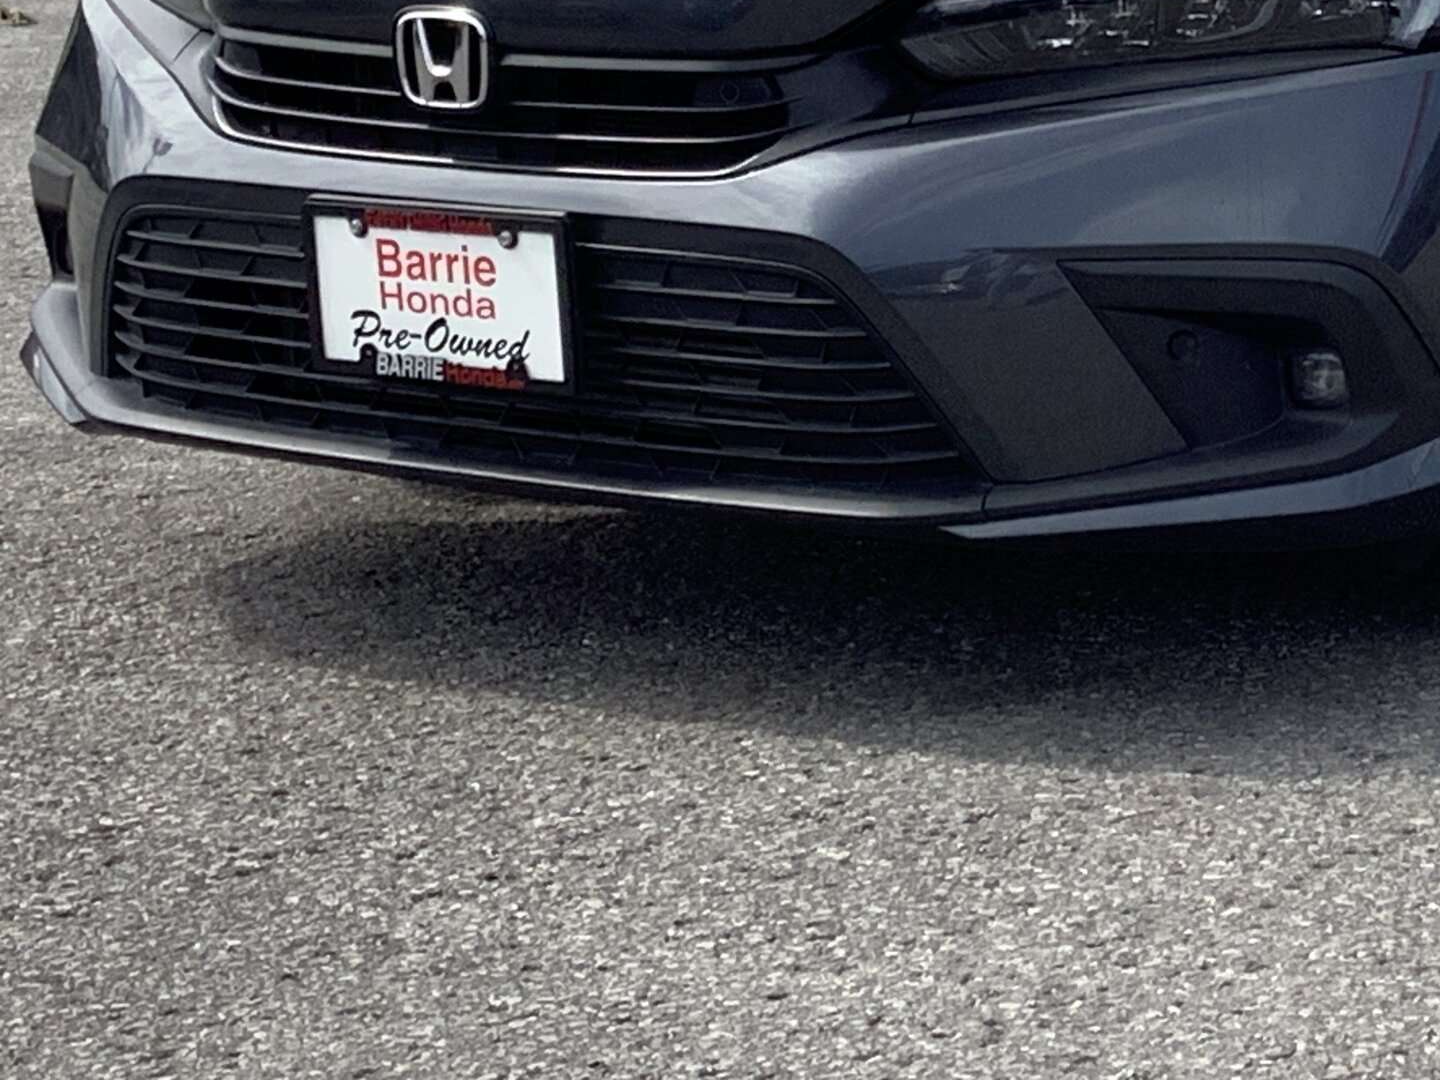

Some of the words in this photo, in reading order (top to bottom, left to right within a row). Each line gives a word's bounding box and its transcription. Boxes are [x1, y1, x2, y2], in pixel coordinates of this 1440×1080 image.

[376, 239, 497, 287] Barrie
[380, 280, 497, 320] Honda
[350, 309, 531, 362] Pre-Owned
